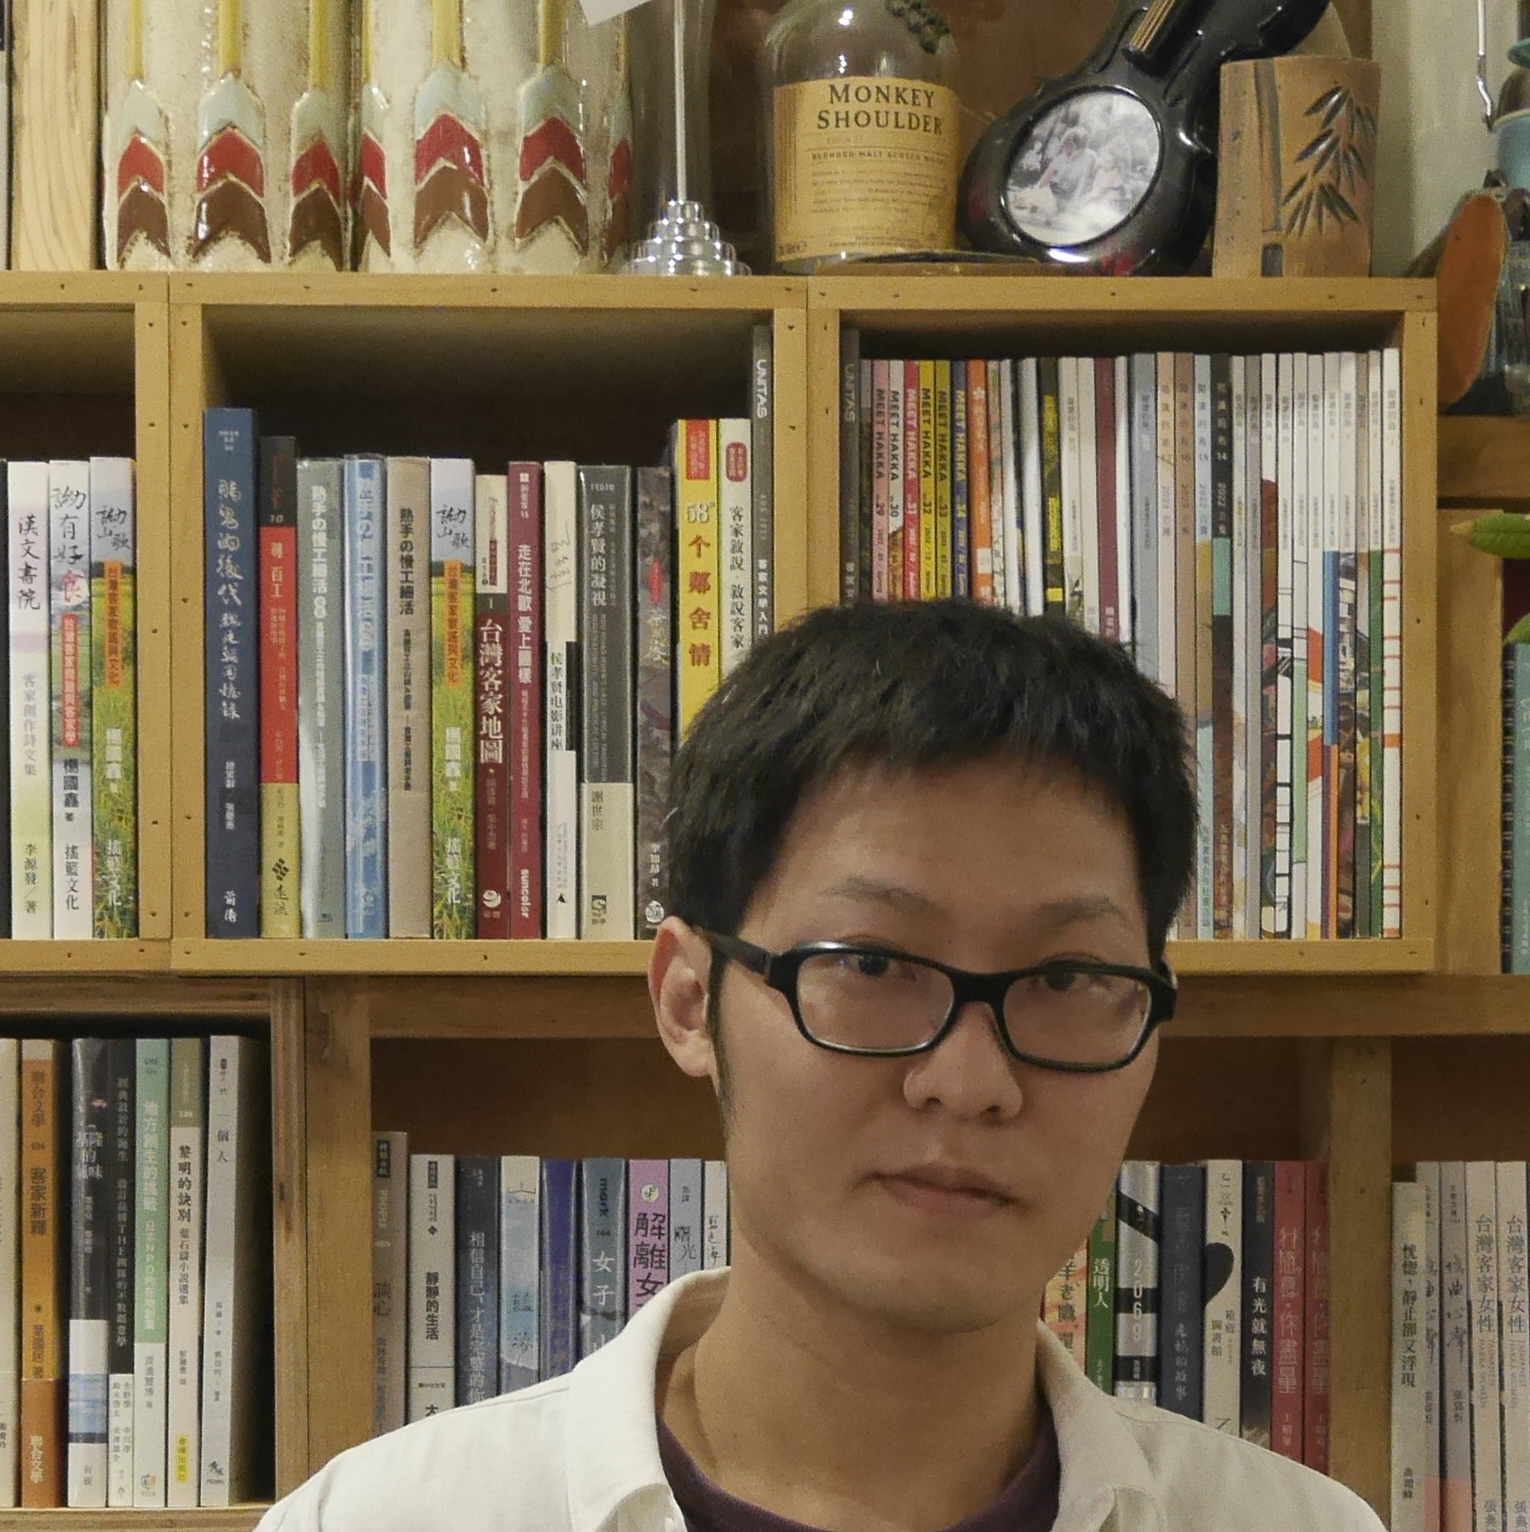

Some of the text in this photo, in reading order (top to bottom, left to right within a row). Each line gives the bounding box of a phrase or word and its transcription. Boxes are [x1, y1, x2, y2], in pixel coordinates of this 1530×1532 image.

[829, 84, 934, 108] MONKEY
[817, 109, 943, 135] SHOULDER
[844, 364, 855, 422] UNITAS
[876, 388, 886, 426] MEET
[890, 390, 900, 428] MEET
[906, 388, 917, 426] MEET
[922, 387, 932, 426] MEET
[938, 390, 948, 429] MEET
[955, 390, 966, 429] MEET
[876, 431, 886, 480] HAKKA
[890, 433, 900, 482] HAKKA
[906, 431, 917, 480] HAKKA
[922, 430, 932, 479] HAKKA
[938, 433, 948, 482] HAKKA
[955, 433, 966, 482] HAKKA
[18, 514, 41, 610] 漢文書院
[399, 507, 414, 616] 熟手の慢工細活
[590, 504, 607, 607] 侯孝賢的凝視
[479, 619, 504, 764] 台灣客家地圖
[177, 1145, 193, 1223] 黎明的訣別
[634, 1212, 667, 1308] 解離女
[1093, 1257, 1111, 1310] 透明人
[1476, 1214, 1495, 1333] 台灣客家女性
[1507, 1214, 1526, 1334] 台灣客家女性
[425, 1271, 440, 1341] 靜靜的生活
[1251, 1276, 1268, 1377] 有光就無夜
